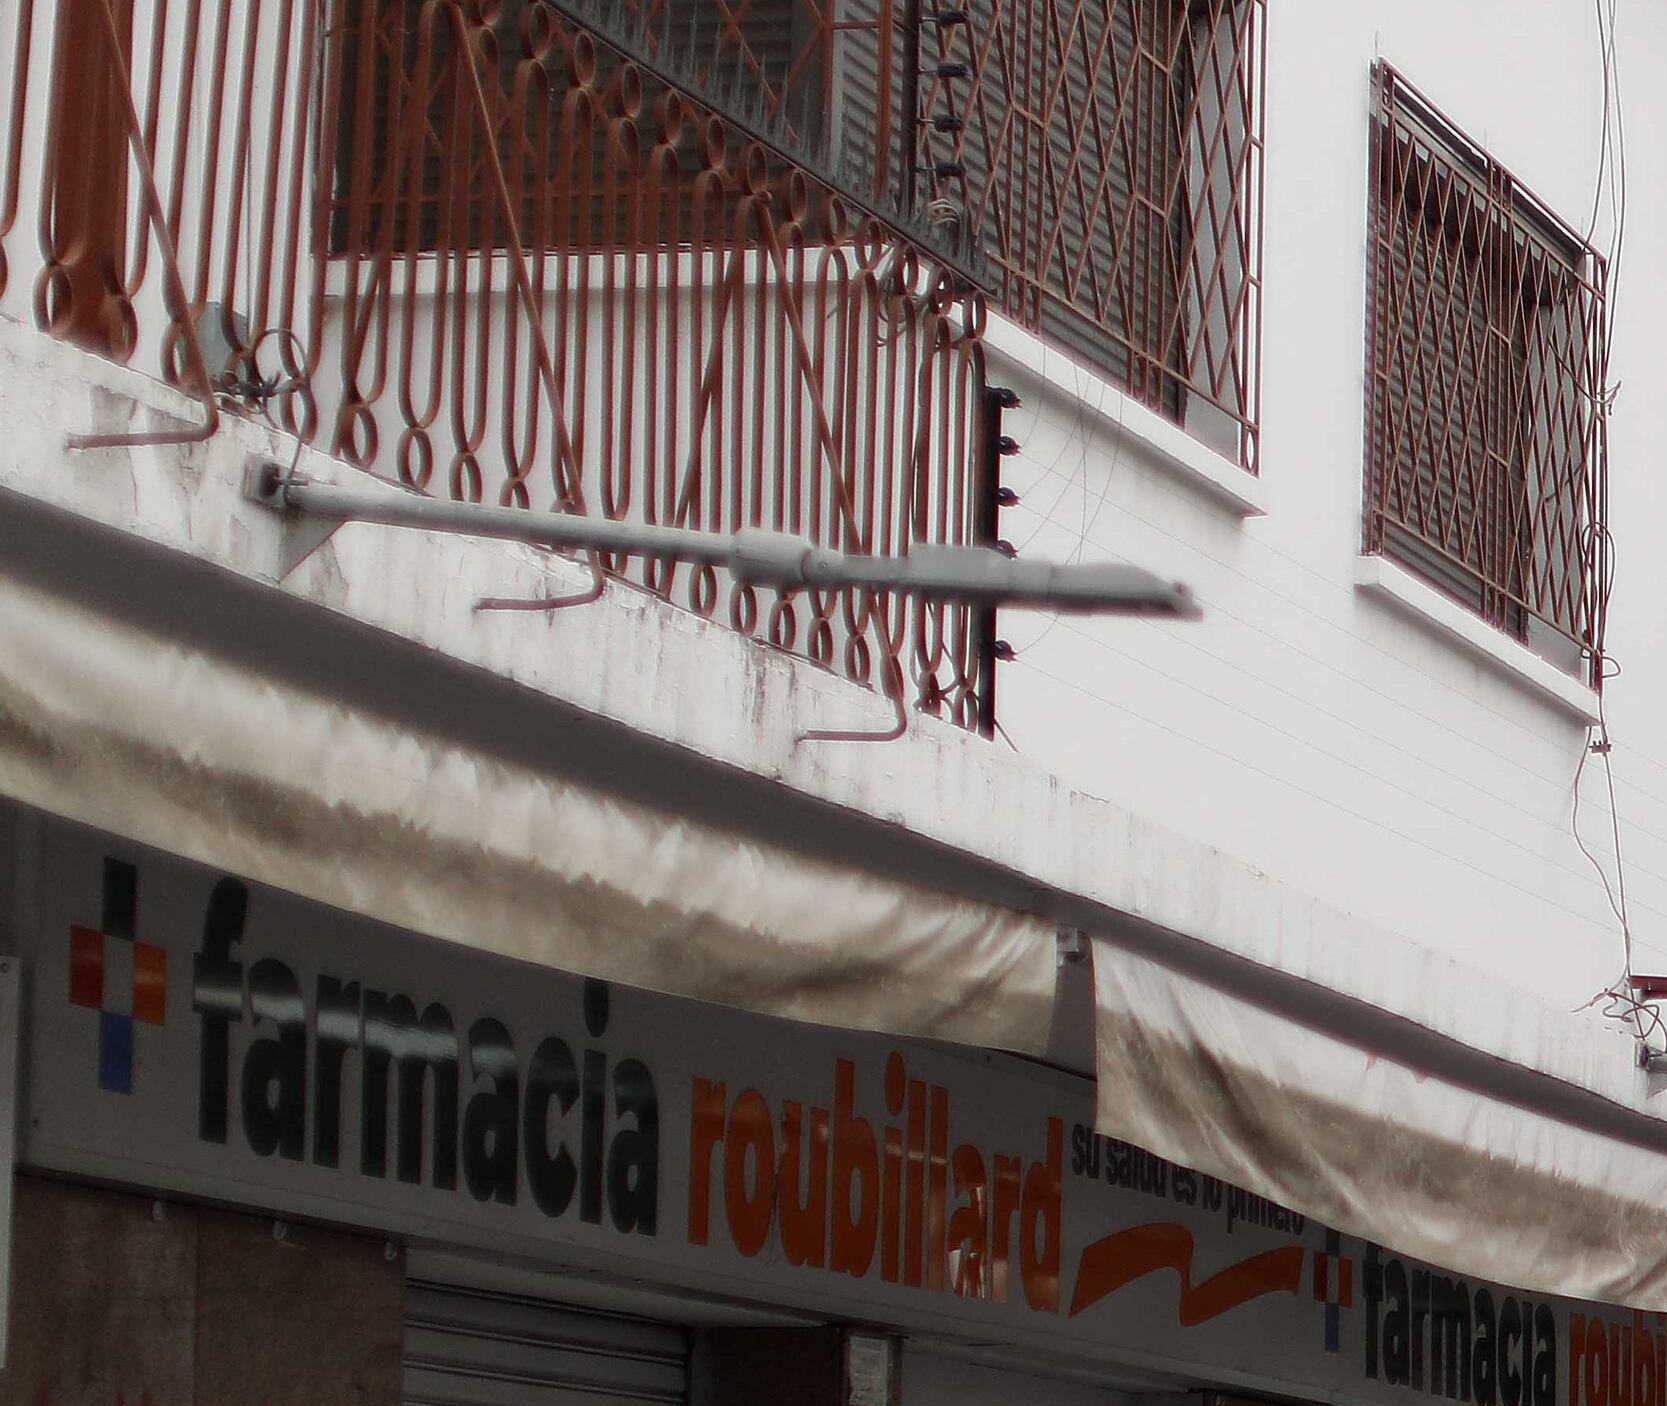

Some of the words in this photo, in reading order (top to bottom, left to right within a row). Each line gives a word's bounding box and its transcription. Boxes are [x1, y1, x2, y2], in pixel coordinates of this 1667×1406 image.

[193, 877, 658, 1236] farmacia
[687, 1051, 1062, 1314] roubillard
[1071, 1123, 1100, 1179] su
